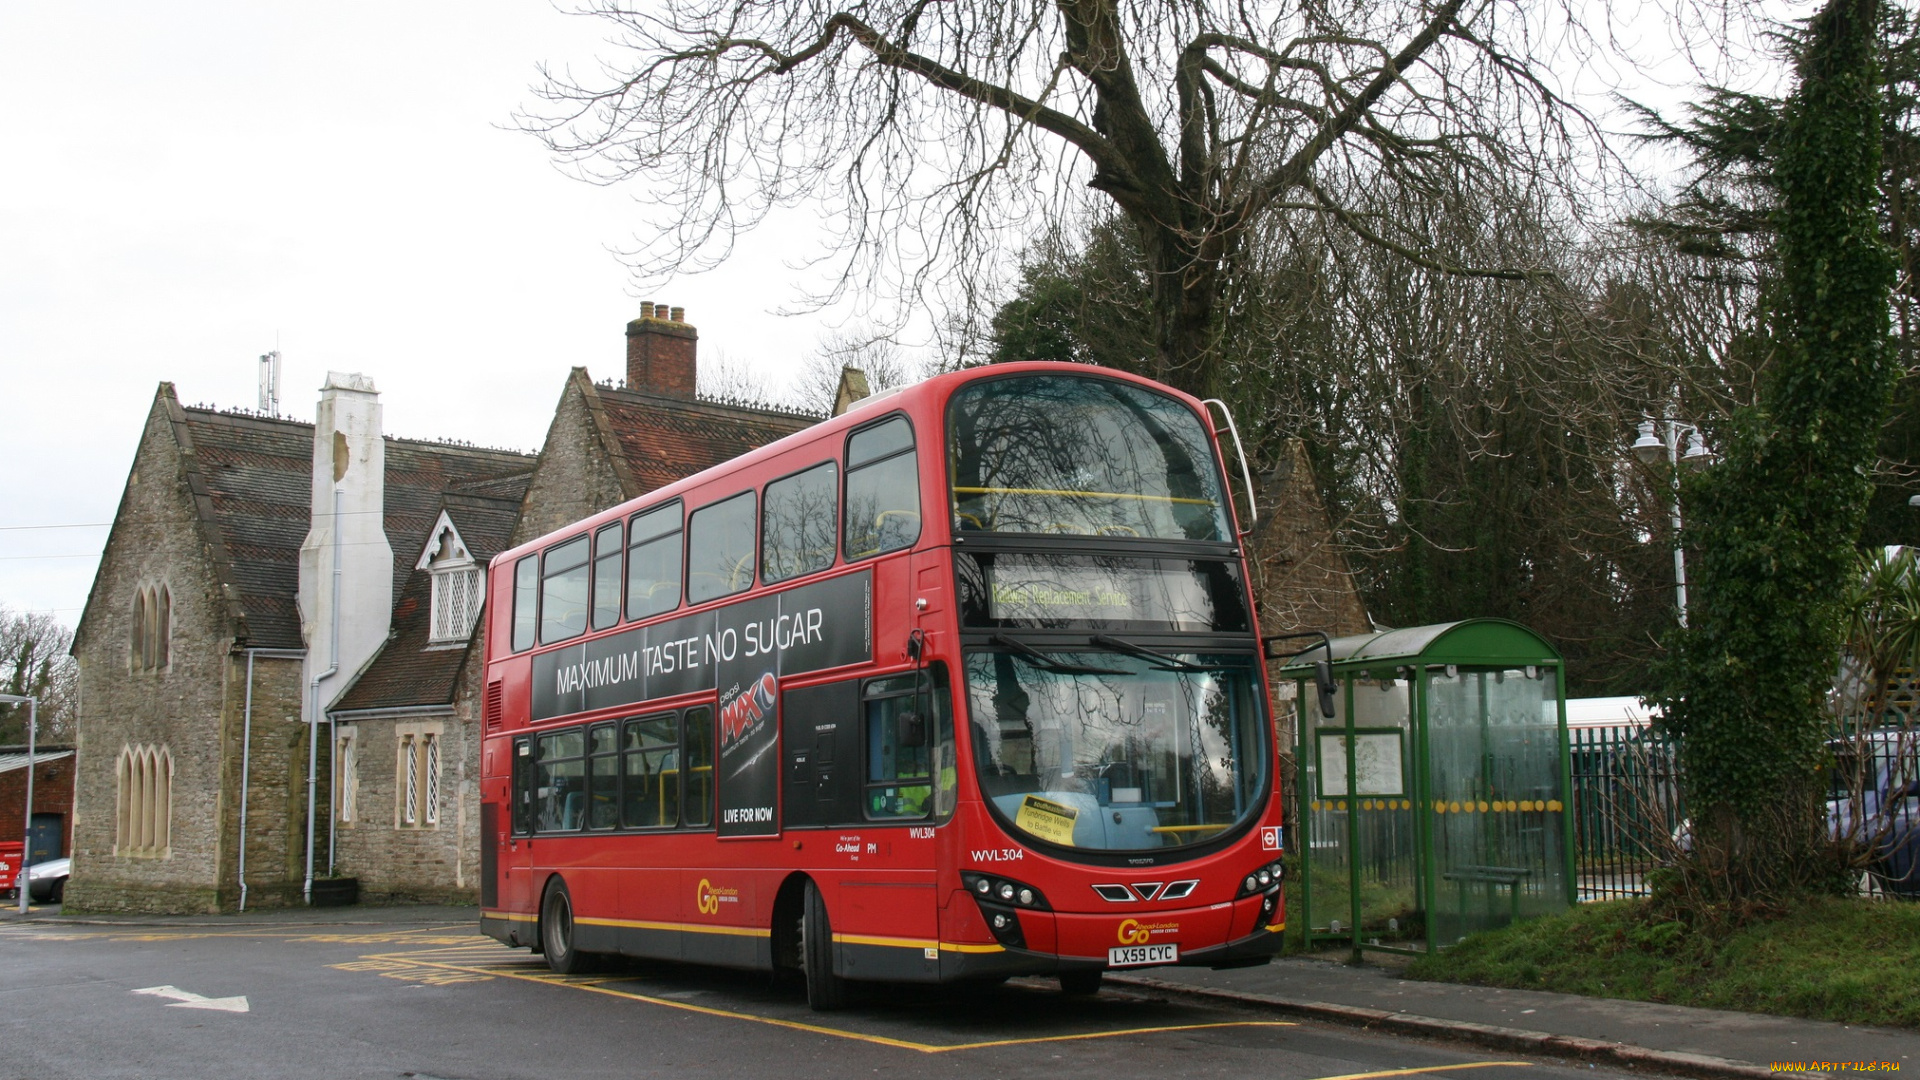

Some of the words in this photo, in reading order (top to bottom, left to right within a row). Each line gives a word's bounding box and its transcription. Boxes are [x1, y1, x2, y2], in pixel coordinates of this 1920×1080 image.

[992, 583, 1028, 609] Railway
[1032, 584, 1091, 609] Replacement
[1095, 586, 1127, 606] Service
[556, 651, 638, 695] MAXIMUM
[642, 637, 699, 677] TASTE
[705, 628, 737, 665] NO
[745, 608, 823, 657] SUGAR
[720, 682, 740, 706] pepsi
[721, 679, 764, 748] MAX
[724, 809, 739, 823] LIVE
[740, 808, 754, 822] FOR
[755, 807, 773, 821] NOW
[1024, 808, 1052, 823] Tunbridge
[1053, 816, 1070, 828] Wells
[1027, 820, 1034, 829] to
[909, 827, 935, 839] WVL304
[835, 843, 860, 852] Go-Ahead
[867, 843, 877, 854] PM
[971, 848, 1023, 862] WVL304
[697, 878, 719, 915] Go
[1117, 918, 1150, 944] Go
[1113, 947, 1146, 964] LX59
[1149, 946, 1172, 961] CYC
